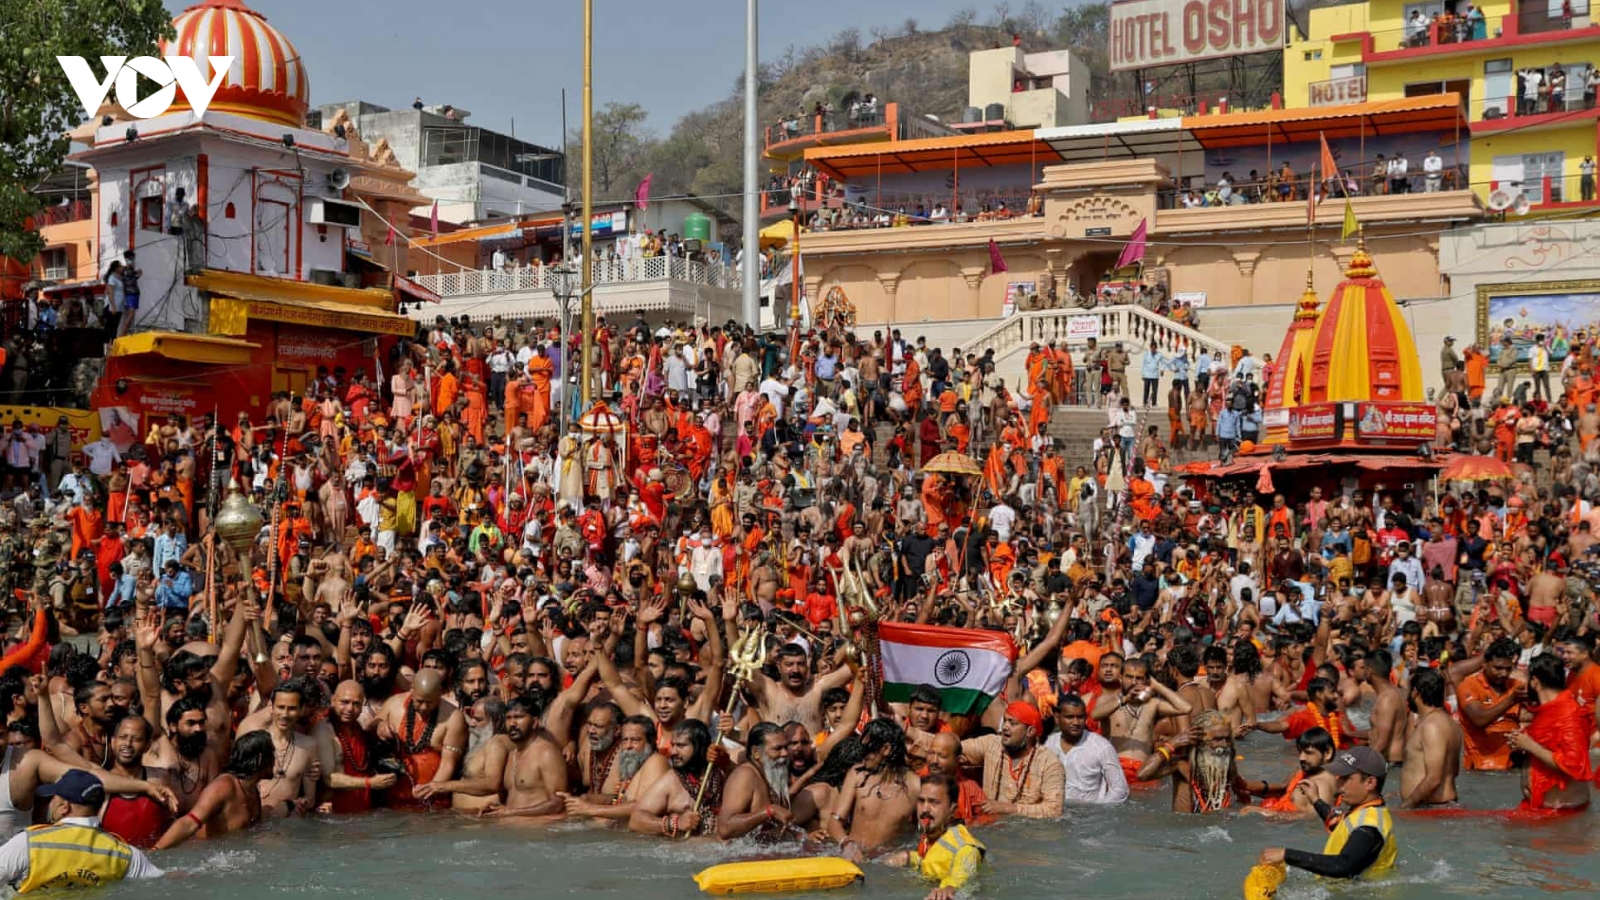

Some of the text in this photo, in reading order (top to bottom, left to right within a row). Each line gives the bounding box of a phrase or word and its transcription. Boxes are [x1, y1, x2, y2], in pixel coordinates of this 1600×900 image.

[1112, 0, 1282, 65] HOTEL OSHO
[1311, 78, 1366, 104] HOTEL
